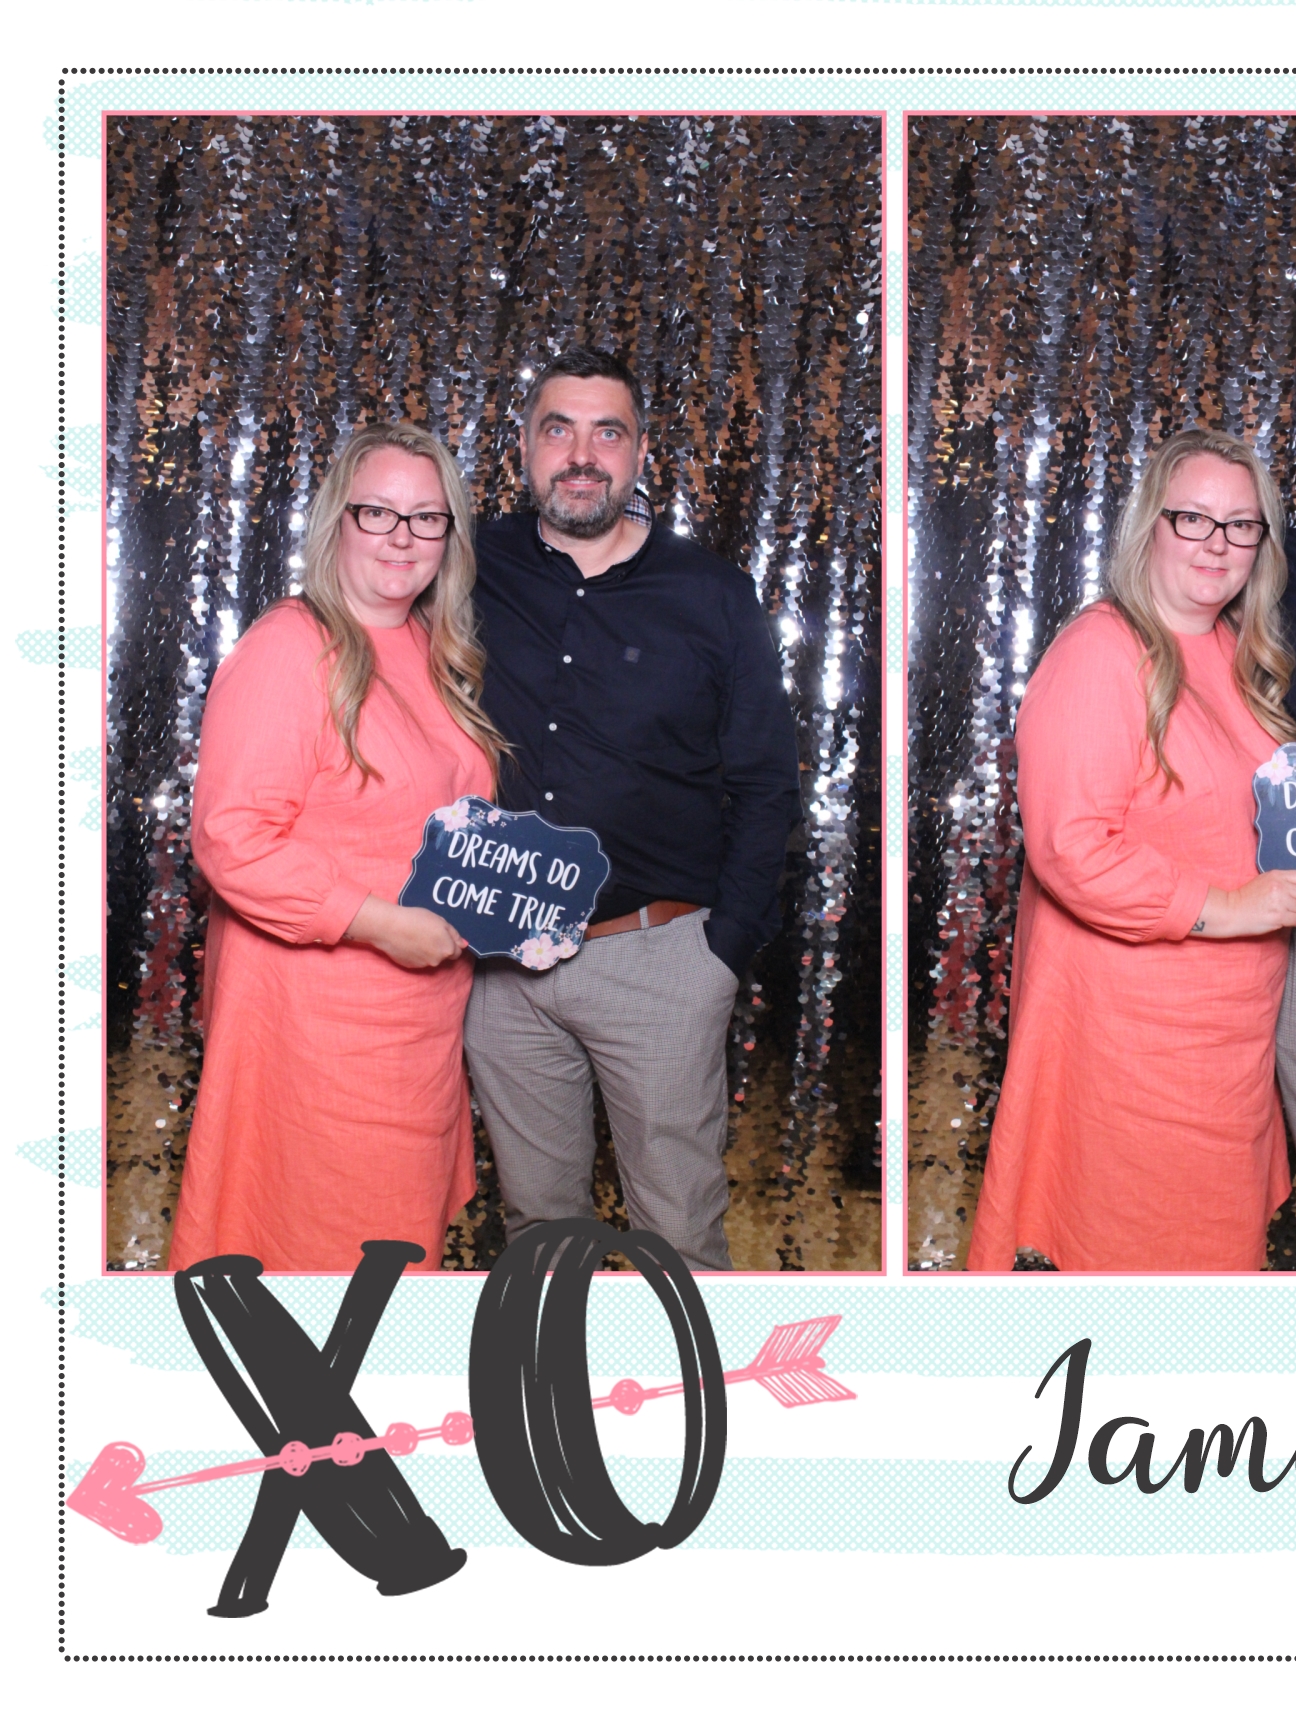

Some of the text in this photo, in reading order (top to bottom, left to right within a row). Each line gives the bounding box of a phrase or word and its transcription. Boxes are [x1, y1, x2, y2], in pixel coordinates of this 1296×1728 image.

[447, 830, 581, 891] DREAMS DO
[432, 876, 566, 932] COME TRUE
